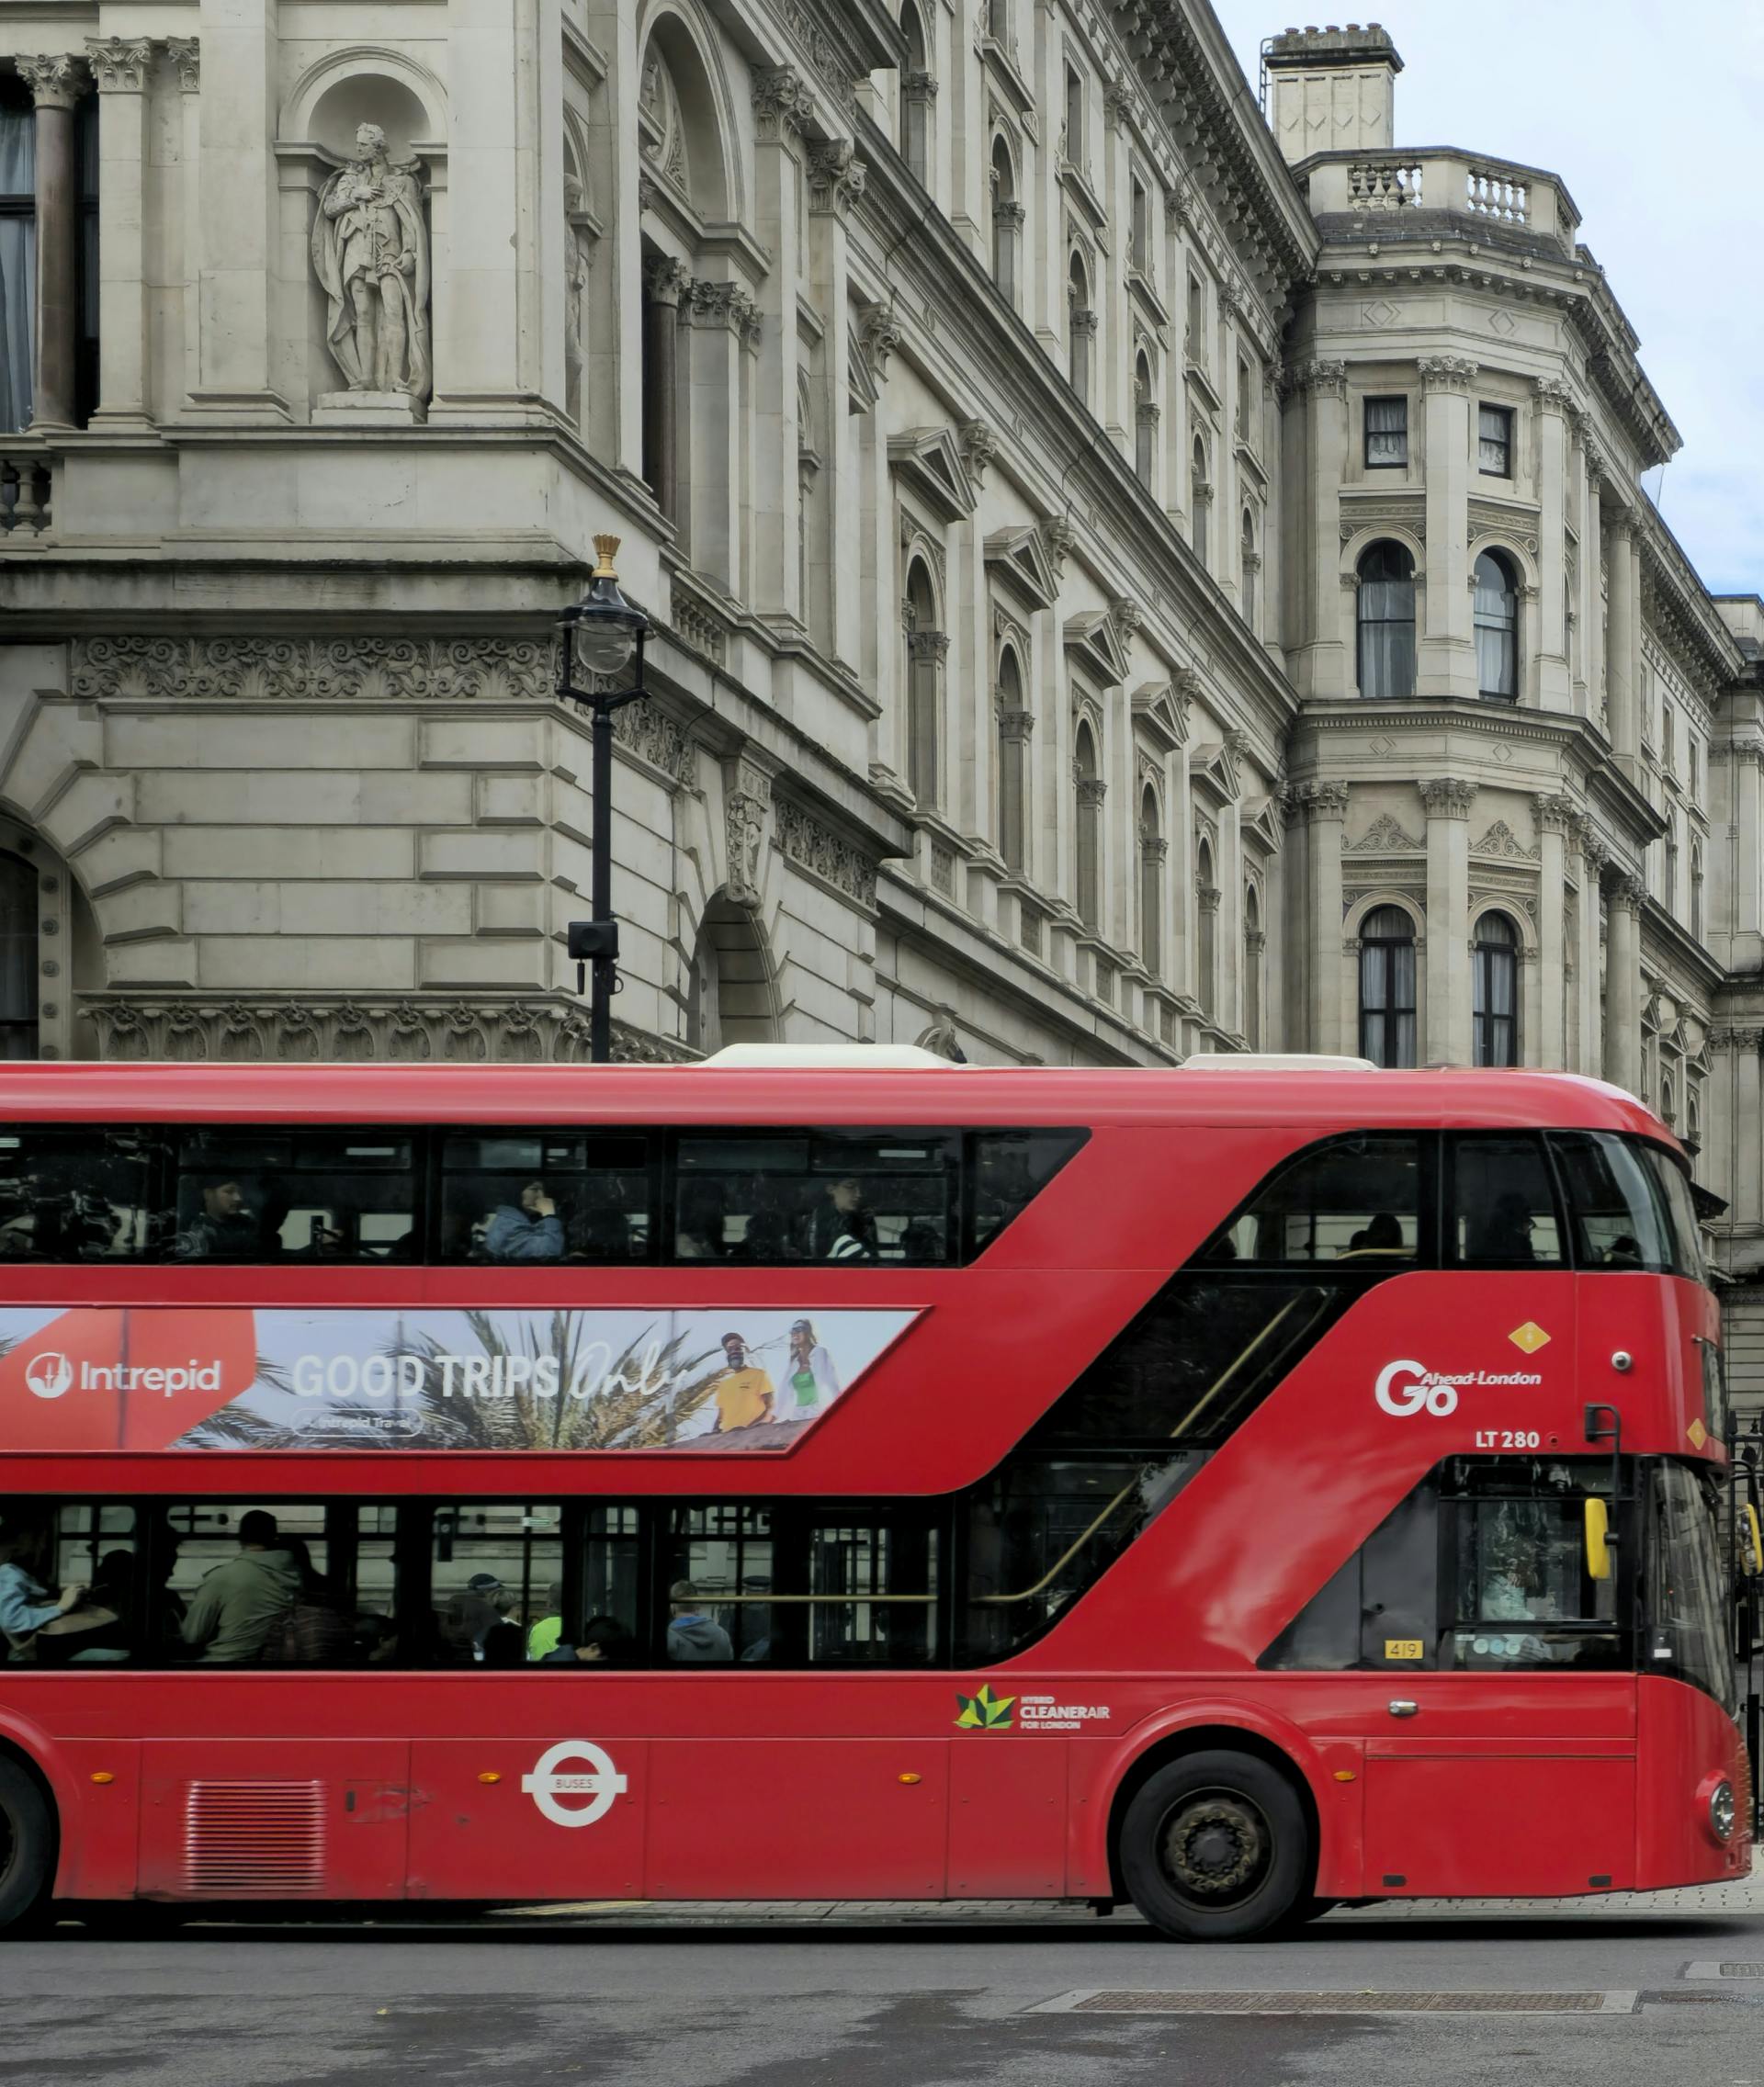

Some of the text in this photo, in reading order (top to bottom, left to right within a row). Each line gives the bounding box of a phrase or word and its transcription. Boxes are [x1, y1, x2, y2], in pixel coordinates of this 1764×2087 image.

[81, 1359, 220, 1397] Intrepid
[294, 1340, 689, 1415] GOOD TRIPS Only
[1375, 1359, 1458, 1416] Go
[1476, 1431, 1540, 1448] LT 280
[1390, 1643, 1417, 1657] 419
[556, 1778, 593, 1788] BUSES
